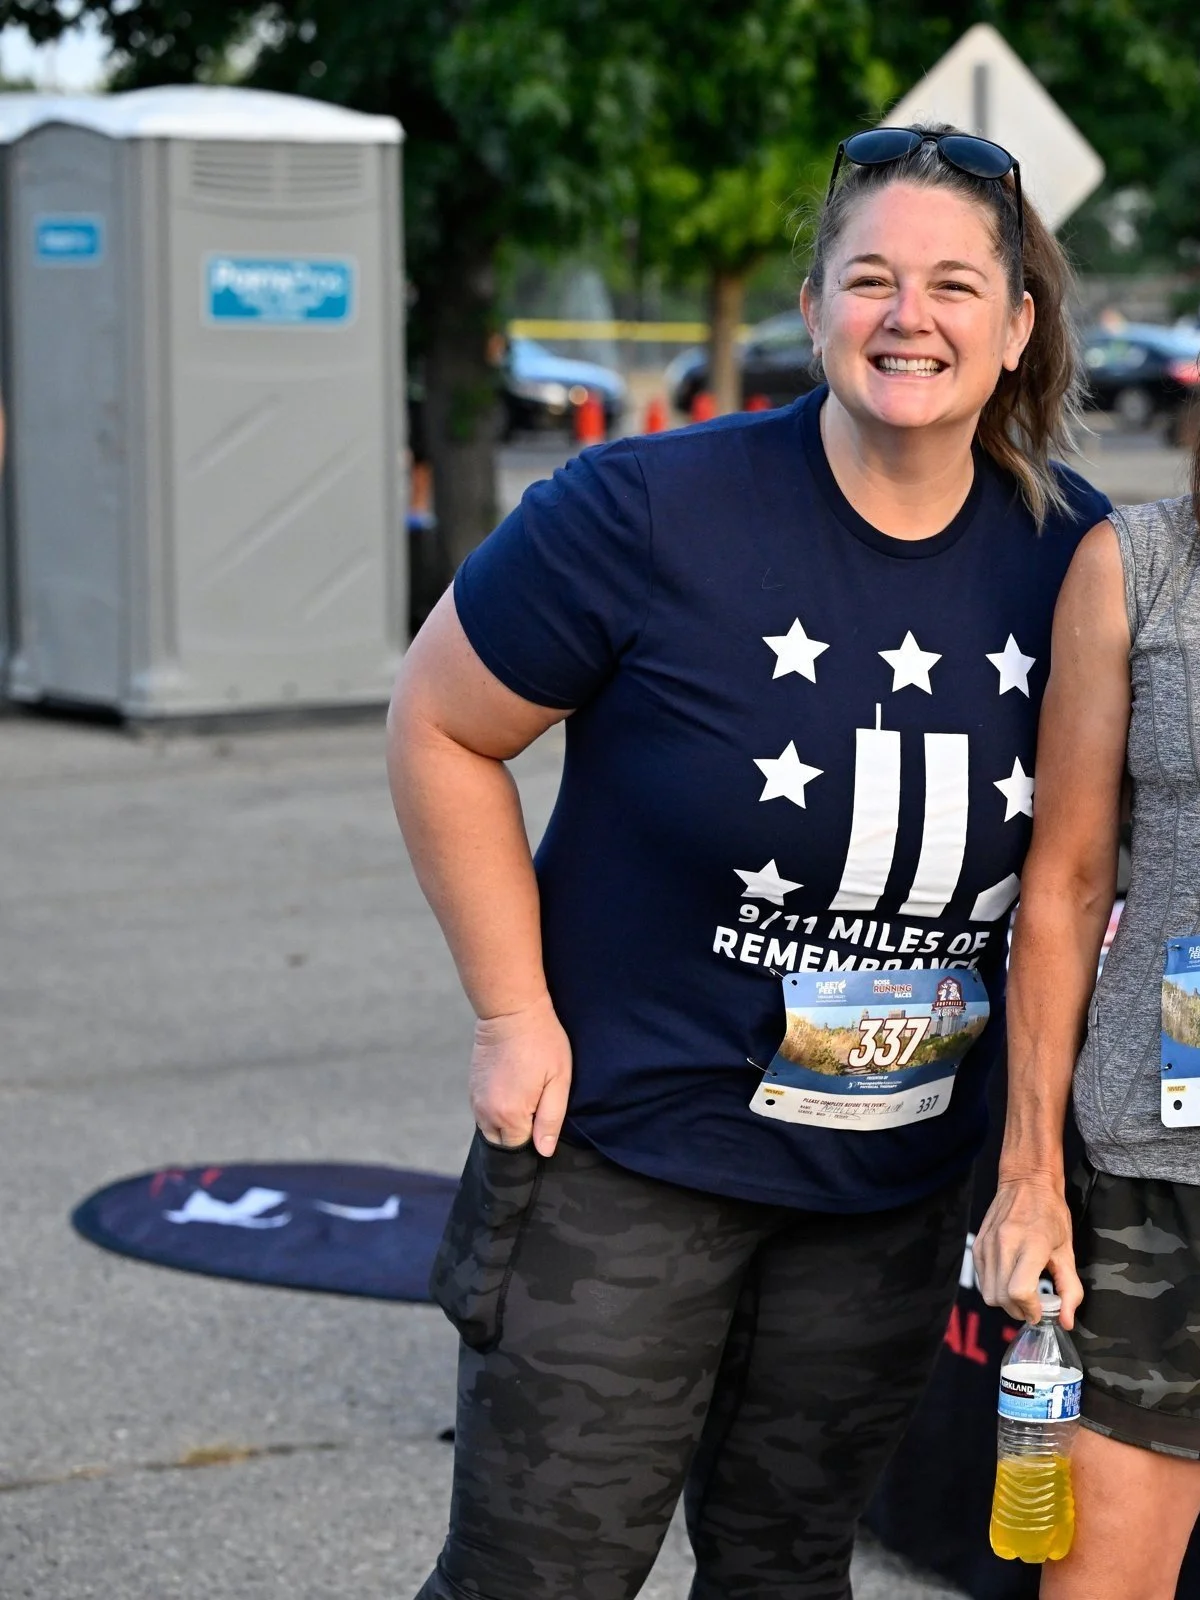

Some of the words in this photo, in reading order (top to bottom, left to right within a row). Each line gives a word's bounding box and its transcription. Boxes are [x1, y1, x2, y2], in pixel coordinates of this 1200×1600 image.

[738, 903, 819, 934] 9/11
[828, 916, 944, 955] MILES
[949, 931, 991, 955] OF
[815, 981, 839, 989] FLEET
[818, 987, 837, 995] FEET
[873, 984, 913, 994] RUNNING
[847, 1016, 932, 1067] 337
[916, 1094, 939, 1114] 337
[1001, 1379, 1034, 1393] KIRKLAND
